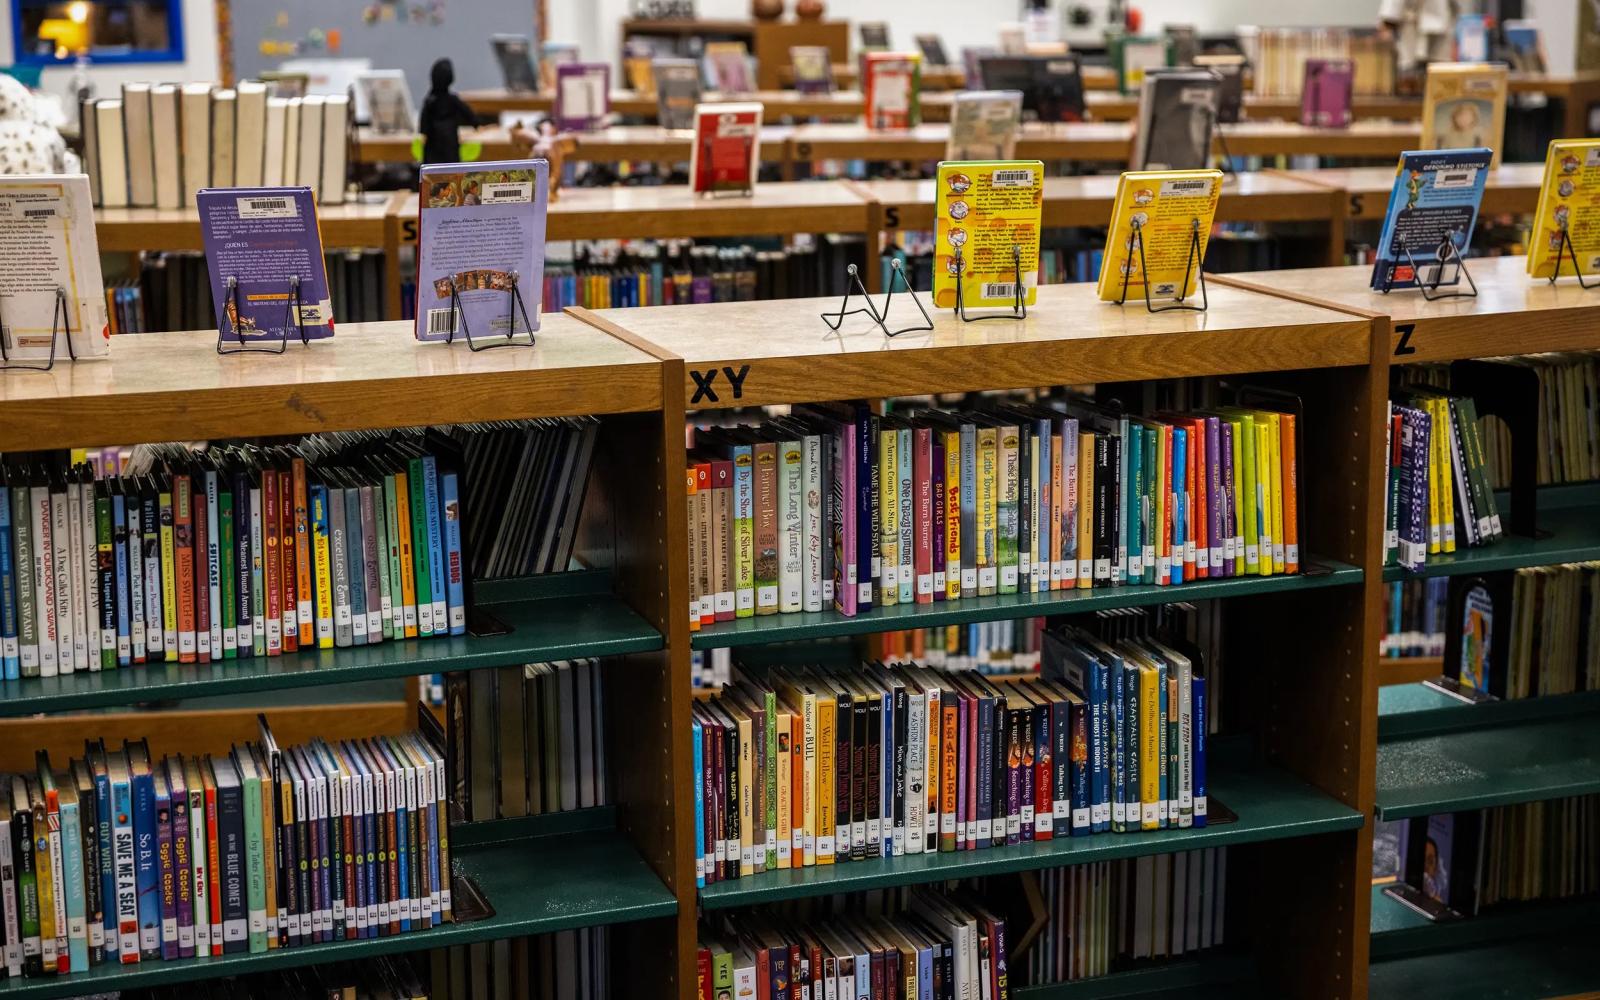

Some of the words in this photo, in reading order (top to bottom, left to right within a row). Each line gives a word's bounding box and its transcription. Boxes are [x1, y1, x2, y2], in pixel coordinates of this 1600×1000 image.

[1351, 194, 1363, 215] S
[886, 207, 899, 229] S
[403, 220, 417, 241] S
[1394, 324, 1416, 355] Z
[809, 440, 818, 465] Deborah
[887, 444, 895, 469] Aurora
[965, 443, 973, 482] mountain
[984, 452, 992, 475] Little
[739, 471, 750, 482] By
[1007, 452, 1016, 478] These
[740, 484, 750, 497] the
[760, 468, 772, 507] Farmer
[790, 467, 800, 491] The
[885, 470, 895, 496] County
[984, 477, 992, 500] Town
[740, 498, 751, 525] Shores
[789, 493, 800, 519] Long
[949, 486, 959, 514] Best
[984, 502, 991, 512] on
[41, 500, 50, 538] DANGER
[86, 504, 95, 528] Wallace
[145, 500, 155, 533] Wallace
[759, 509, 773, 528] Boy
[888, 498, 896, 532] All-Stars
[984, 514, 992, 527] the
[430, 516, 439, 549] MYSTERY
[740, 526, 750, 536] of
[790, 521, 800, 557] Winter
[808, 534, 819, 552] Ruby
[949, 517, 959, 554] Friends
[42, 540, 51, 551] IN
[240, 541, 249, 569] Meanest
[741, 537, 750, 559] Silver
[17, 526, 30, 600] BLACKWATER
[56, 556, 67, 573] Dog
[88, 544, 99, 574] SNOT
[210, 543, 218, 587] SUITCASE
[450, 551, 459, 566] RED
[741, 560, 751, 581] Lake
[810, 555, 818, 584] Lavender
[43, 553, 53, 607] QUICKSAND
[58, 574, 68, 597] Called
[104, 572, 112, 582] The
[133, 574, 141, 588] Pick
[146, 563, 156, 584] Danger
[241, 571, 249, 594] Hound
[451, 567, 460, 583] DOG
[90, 577, 100, 610] STEW
[103, 583, 113, 604] Legend
[134, 590, 141, 599] of
[134, 600, 142, 611] the
[58, 599, 69, 618] Kitty
[242, 595, 250, 620] Around
[21, 601, 32, 640] SWAMP
[46, 608, 54, 641] SWAMP
[805, 700, 813, 723] shadow
[805, 736, 814, 760] BULL
[822, 726, 832, 749] Wolf
[821, 751, 832, 785] Hollow
[929, 744, 937, 771] Harbor
[945, 713, 954, 813] FEARLES
[929, 773, 936, 787] Me
[1010, 770, 1019, 801] Searching
[1023, 768, 1032, 800] Searching
[1041, 769, 1049, 791] Calling
[1077, 773, 1085, 795] Talking
[100, 822, 110, 844] GUY
[139, 833, 151, 848] So
[117, 833, 133, 859] SAVE
[141, 850, 152, 860] B.
[160, 842, 171, 868] Oggie
[177, 836, 187, 864] Oggie
[250, 840, 259, 852] Ivy
[101, 847, 112, 875] WIRE
[118, 863, 132, 877] ME
[227, 853, 239, 876] BLUE
[251, 854, 259, 875] Takes
[164, 873, 173, 905] Cooder
[179, 868, 189, 902] Cooder
[228, 877, 240, 906] COMET
[252, 876, 260, 890] Care
[120, 892, 134, 916] SEAT
[998, 975, 1007, 987] 15
